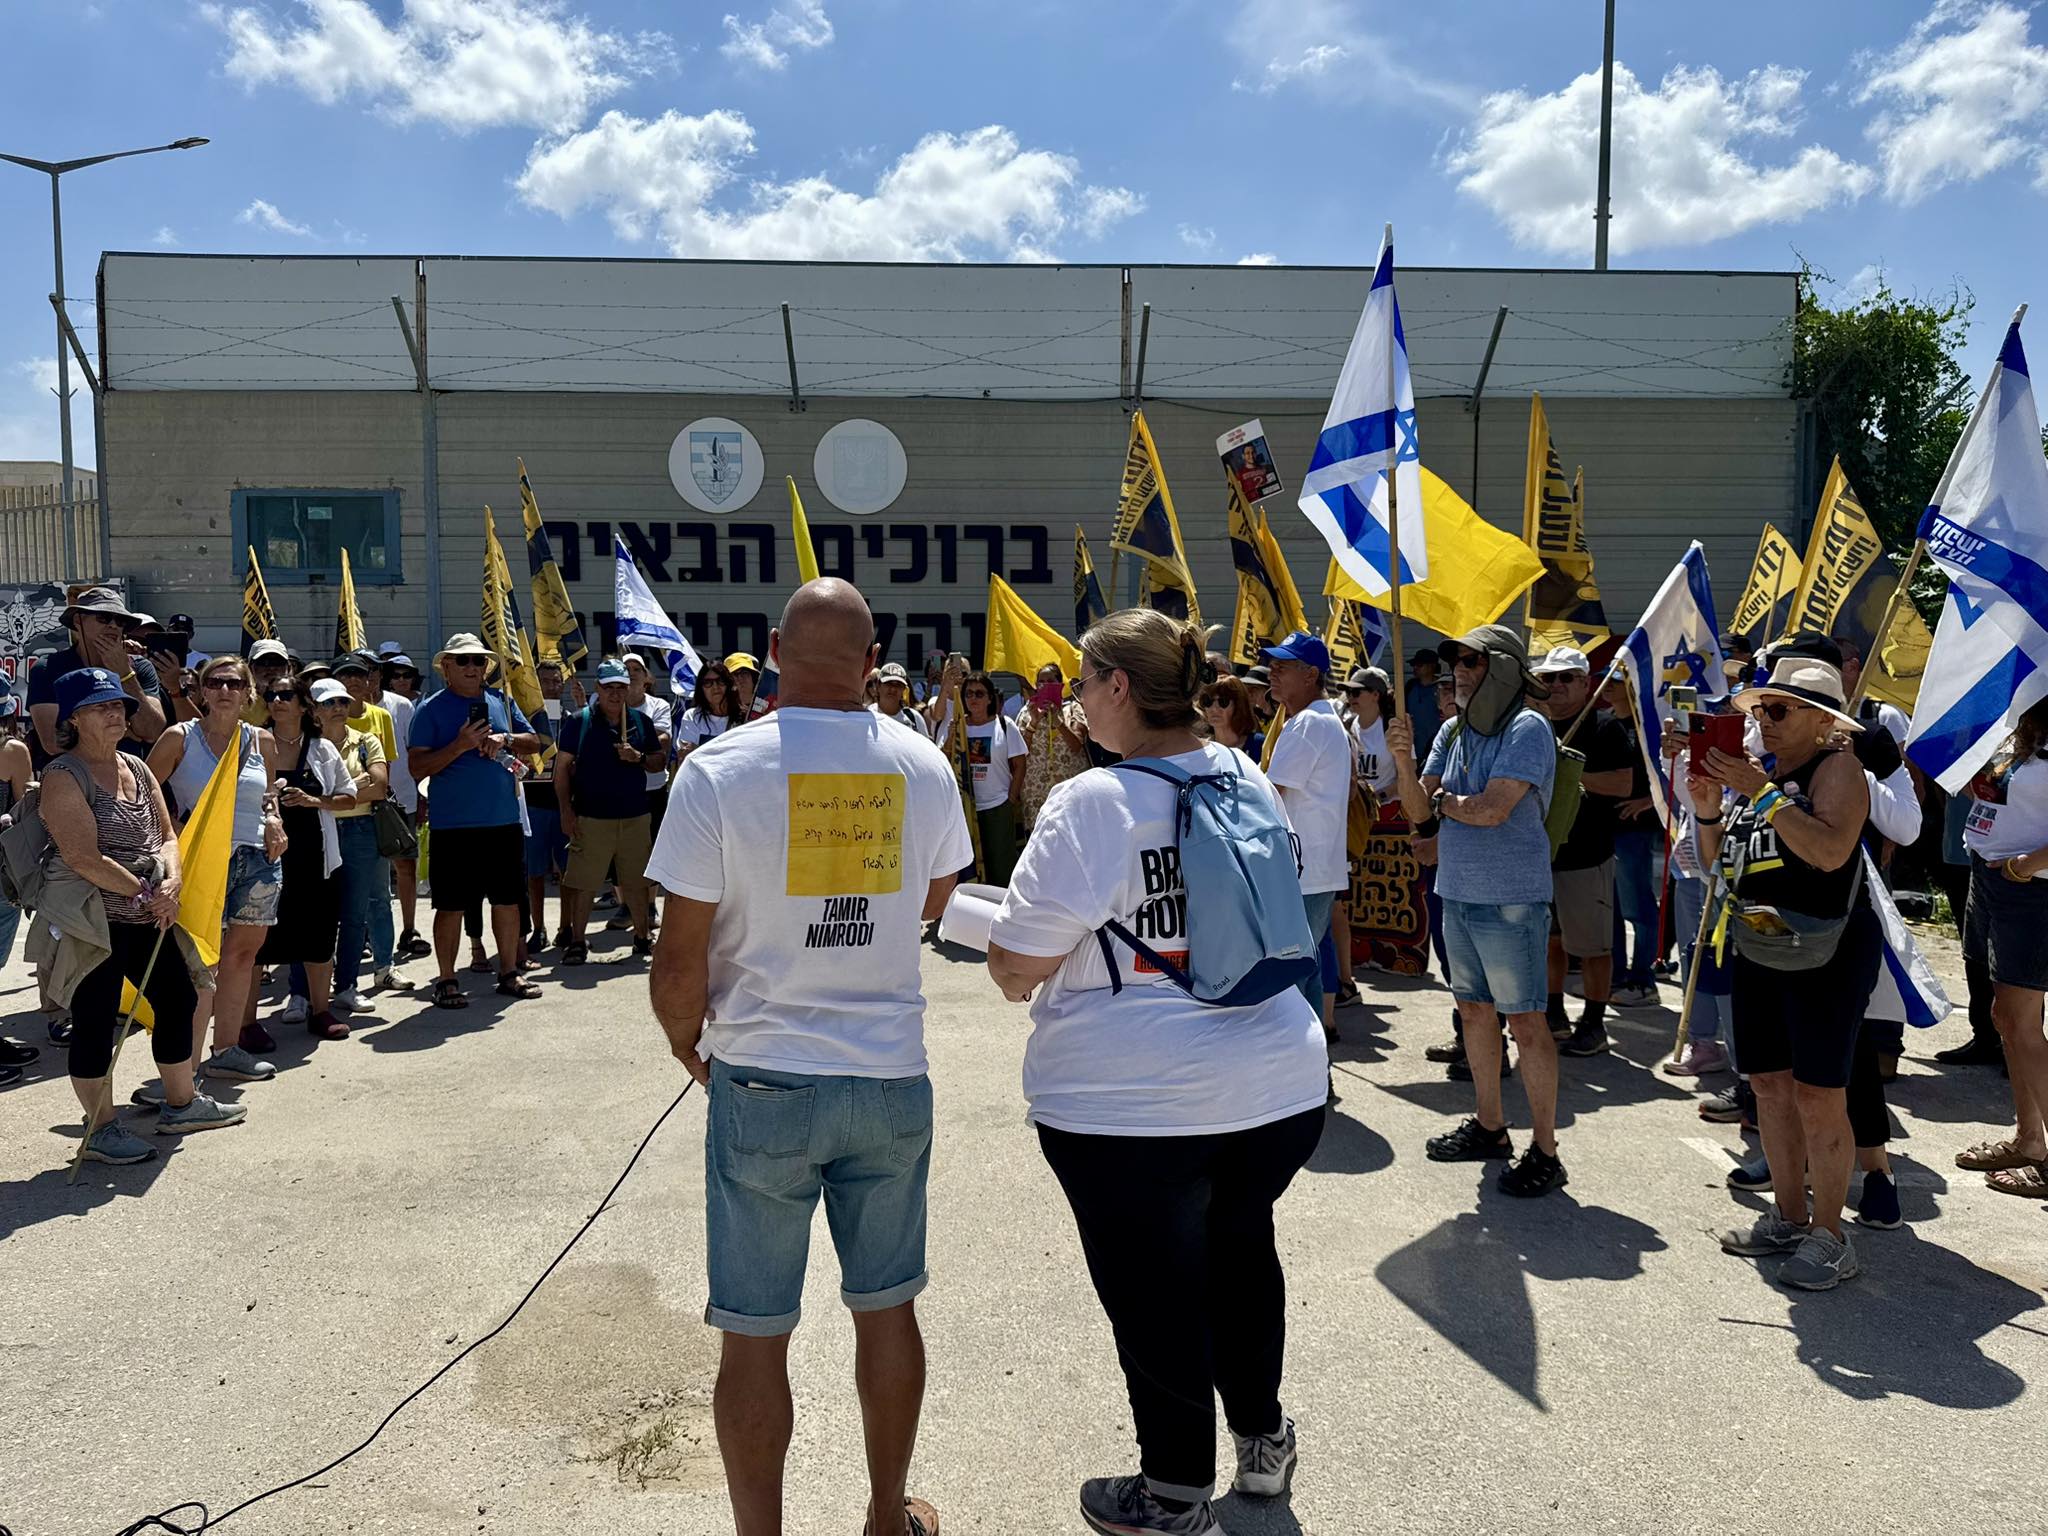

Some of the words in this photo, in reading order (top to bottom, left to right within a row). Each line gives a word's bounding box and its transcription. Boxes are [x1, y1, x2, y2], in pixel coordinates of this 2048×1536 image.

[809, 524, 1053, 583] ברוכים
[1363, 839, 1414, 858] אנחנ
[1140, 846, 1184, 895] BR
[822, 897, 869, 923] TAMIR
[805, 922, 874, 948] NIMRODI
